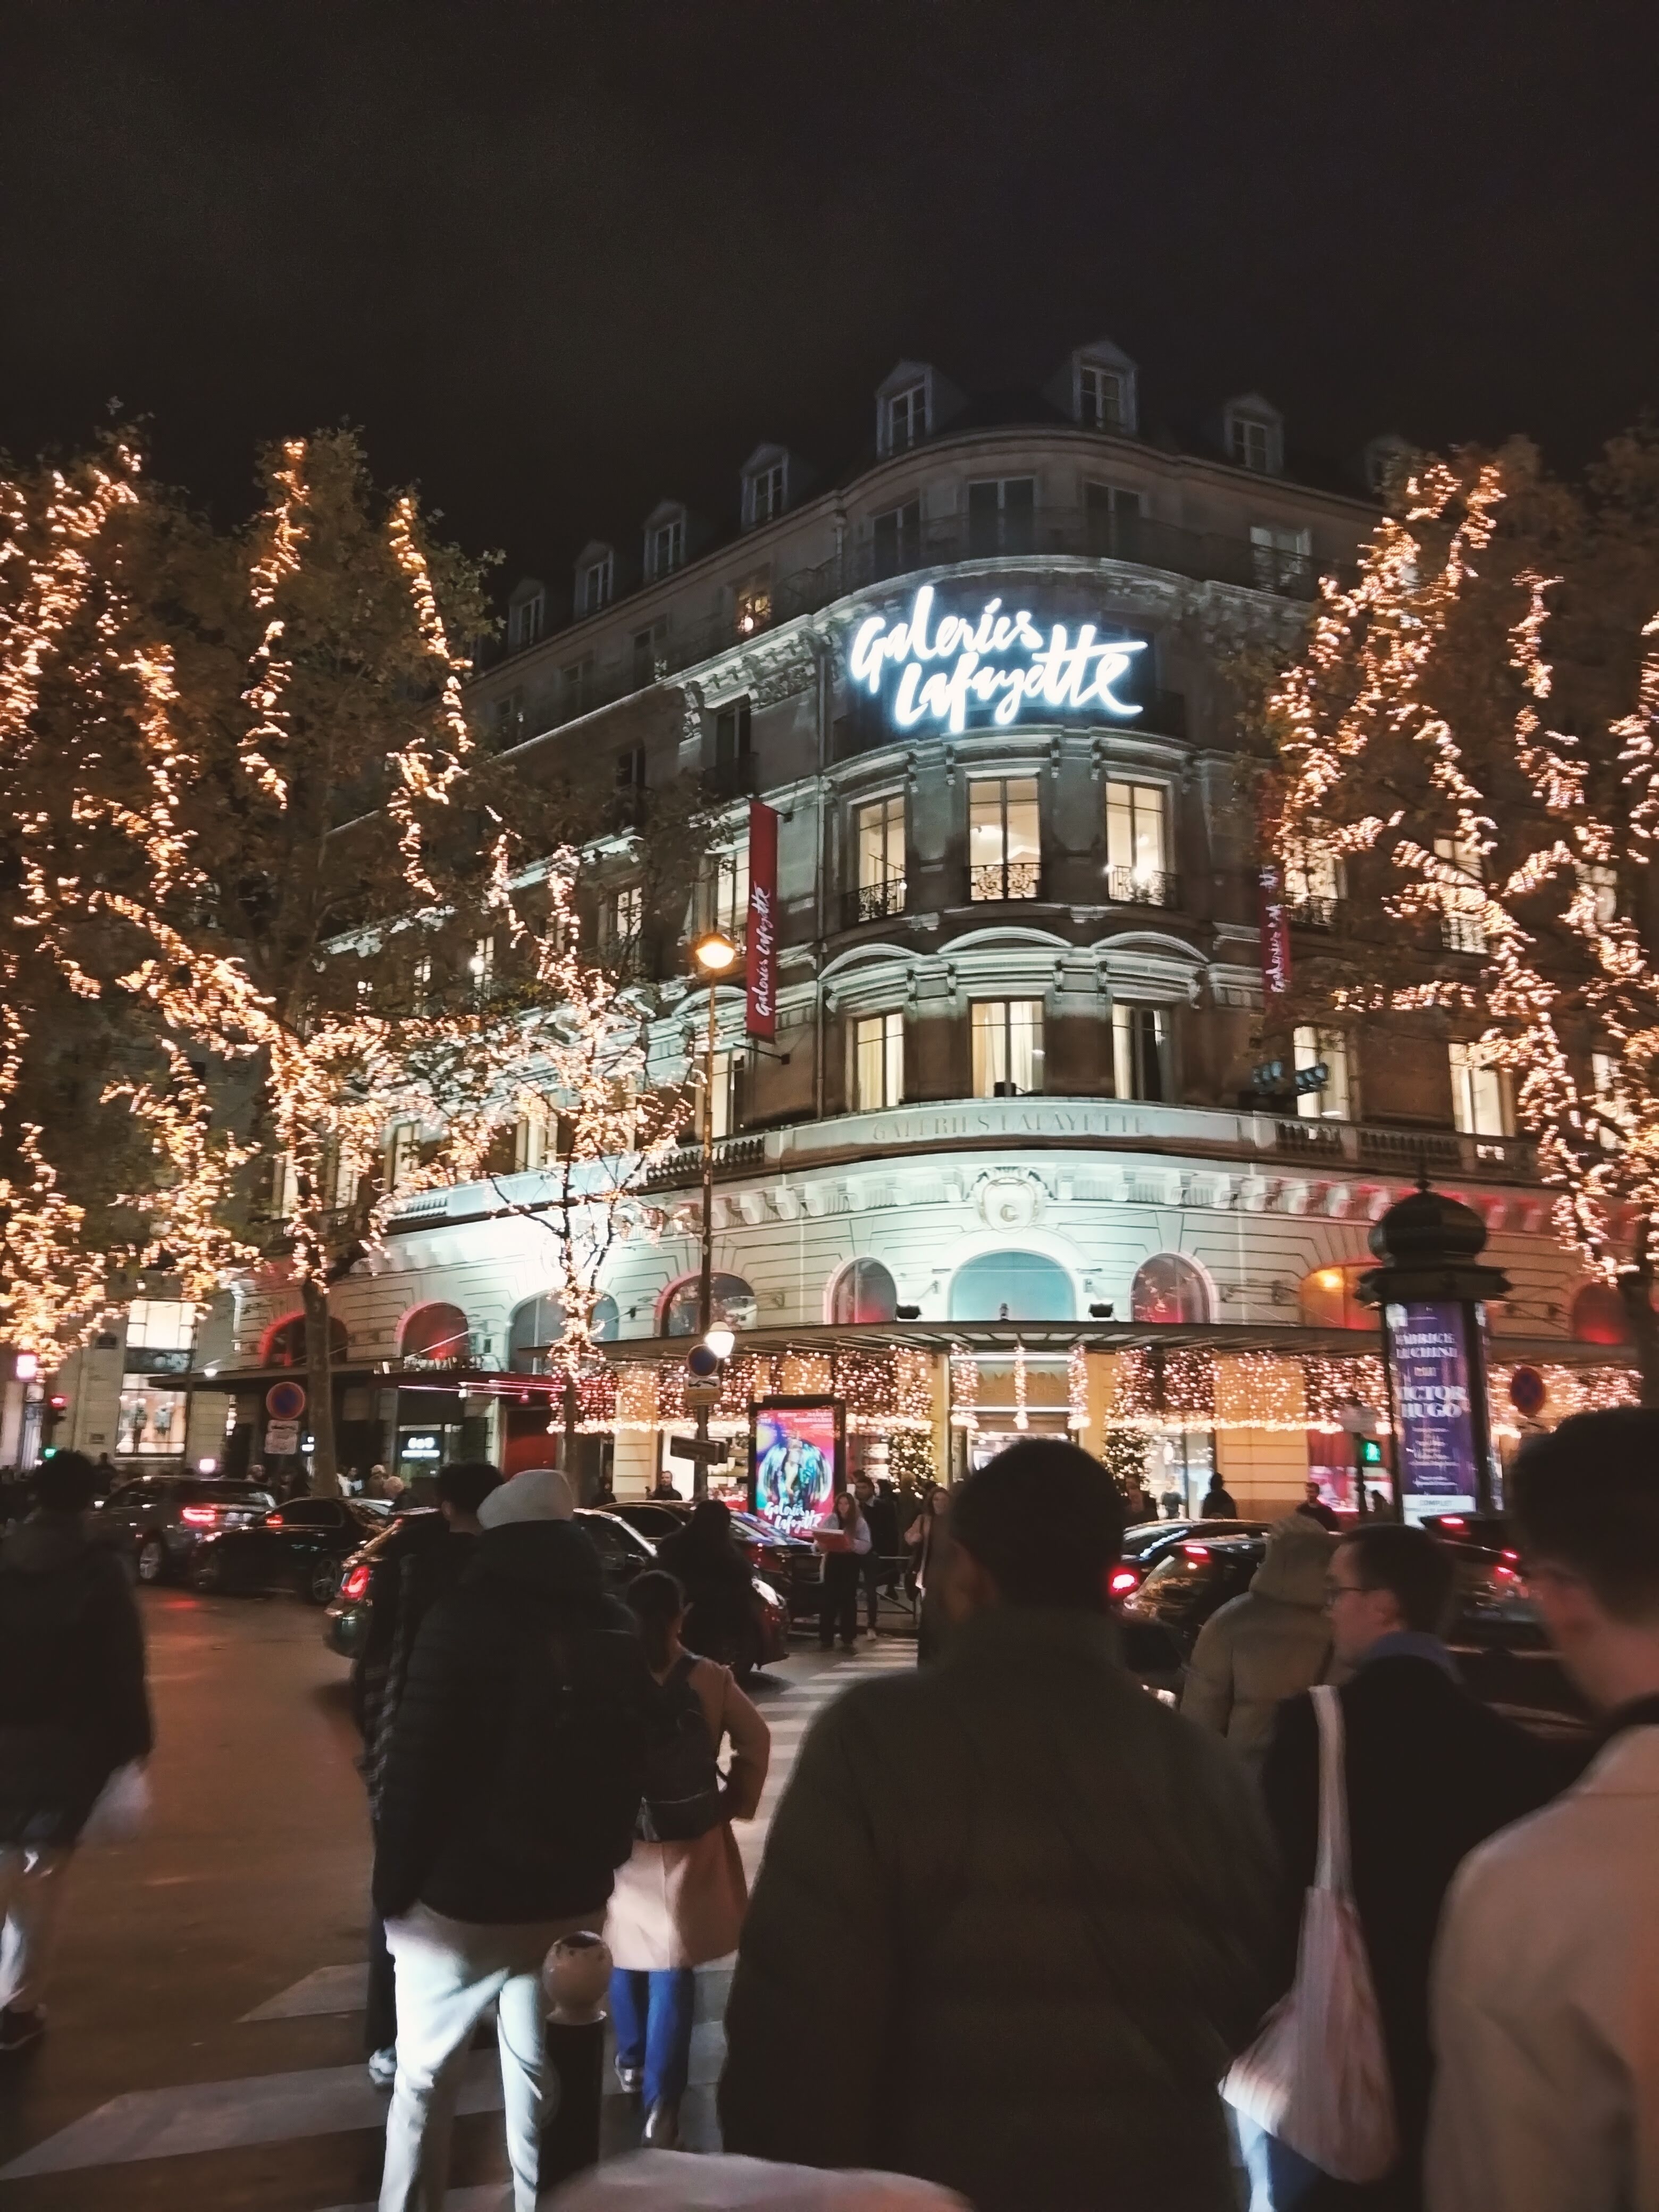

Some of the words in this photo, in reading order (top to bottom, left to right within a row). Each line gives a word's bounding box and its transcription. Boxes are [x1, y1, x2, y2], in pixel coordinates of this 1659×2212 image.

[851, 585, 1043, 693] Galeries
[894, 624, 1148, 733] Lafayette
[751, 881, 774, 955] Lafayette
[751, 959, 773, 1016] Galeries
[1401, 1403, 1462, 1418] HUGO
